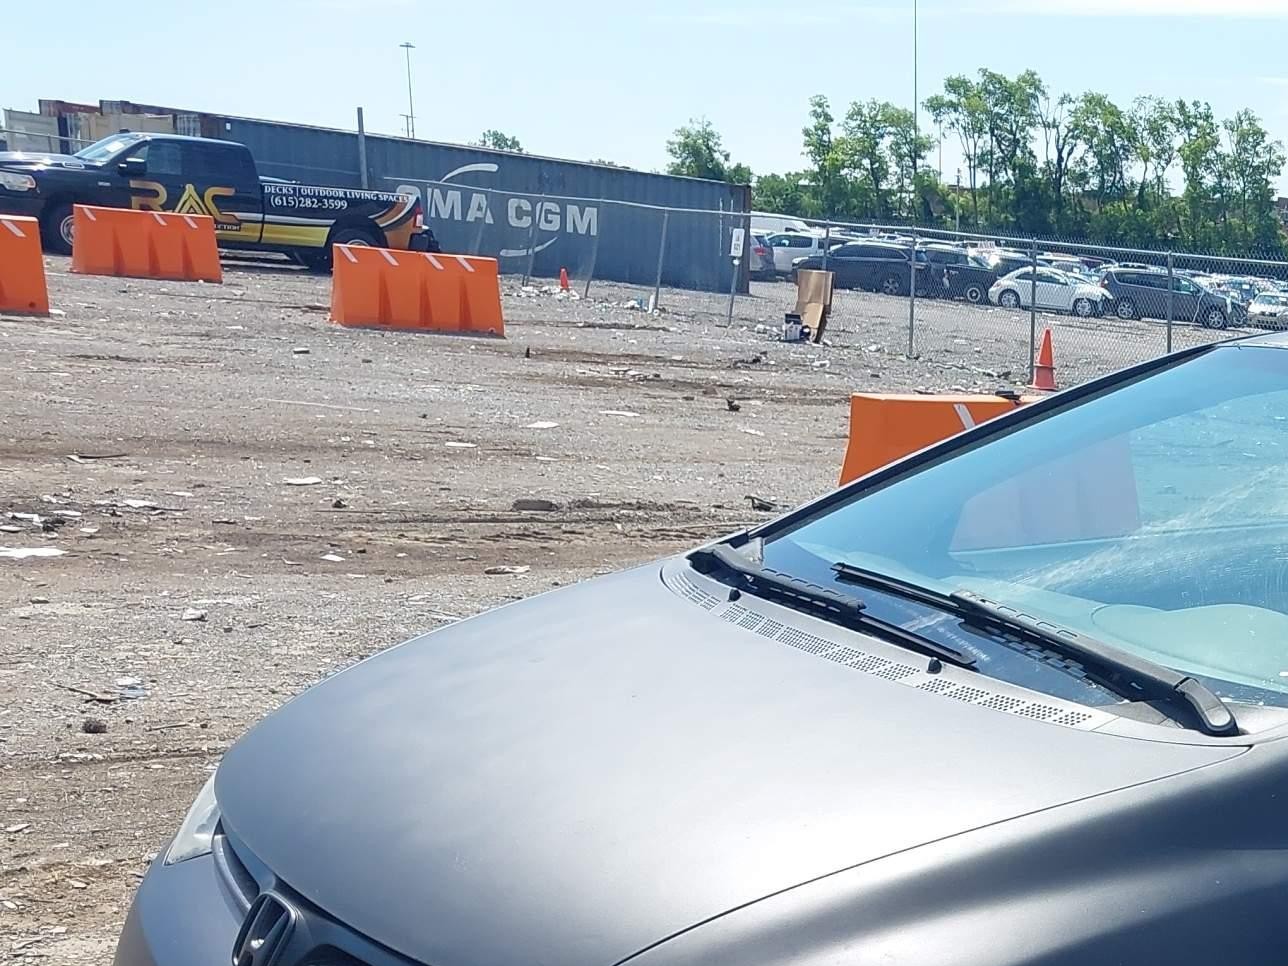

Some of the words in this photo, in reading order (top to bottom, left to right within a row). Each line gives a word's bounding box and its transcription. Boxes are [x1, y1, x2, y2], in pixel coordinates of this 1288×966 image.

[129, 180, 241, 223] RAC
[264, 185, 294, 195] DECKS
[300, 187, 345, 198] OUTDOOR
[346, 191, 377, 201] LIVING
[378, 194, 409, 203] SPACES
[270, 195, 348, 209] (615)282-3599
[507, 198, 598, 236] CGM
